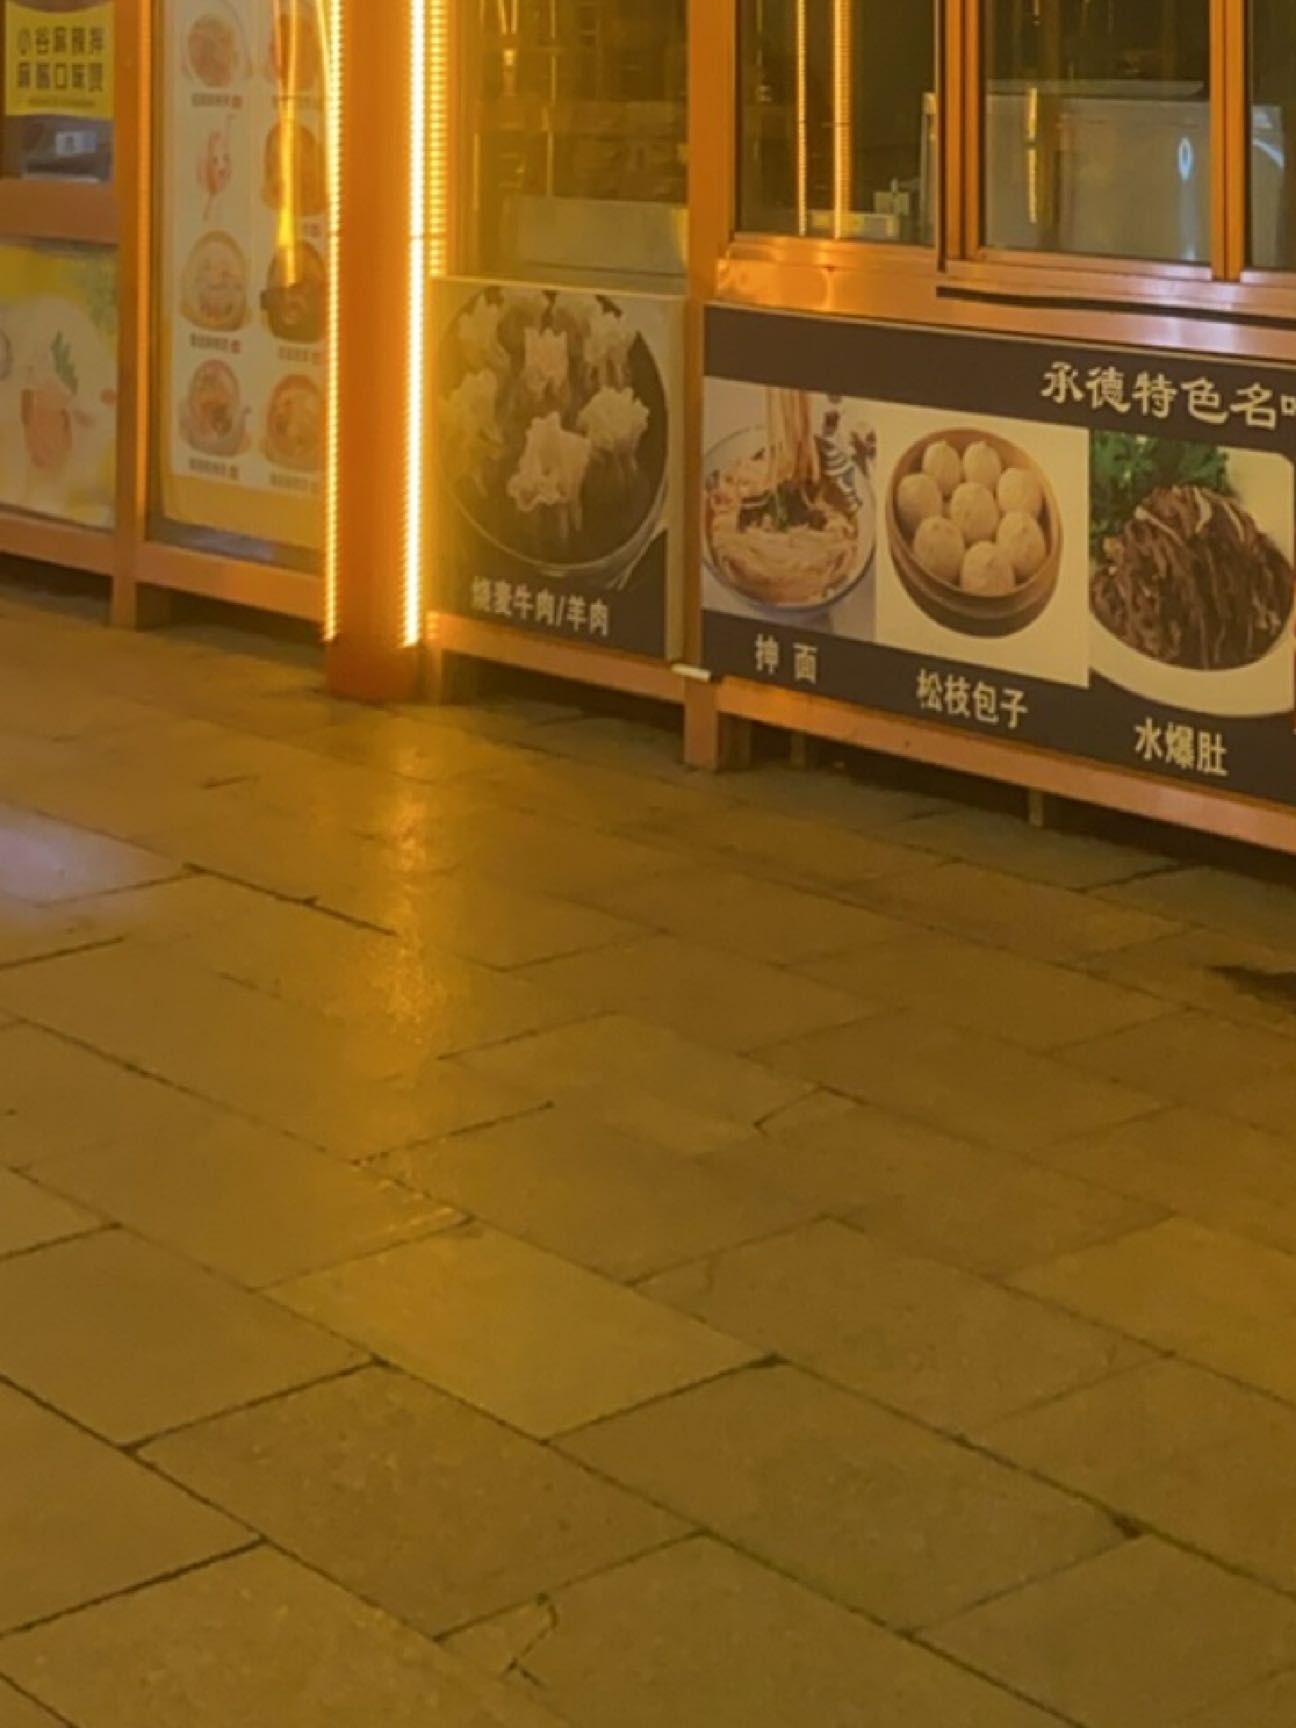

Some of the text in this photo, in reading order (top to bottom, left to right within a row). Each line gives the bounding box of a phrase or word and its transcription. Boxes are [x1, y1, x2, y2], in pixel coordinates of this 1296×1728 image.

[915, 669, 1028, 728] 松枝包子
[1134, 718, 1228, 776] 水爆肚
